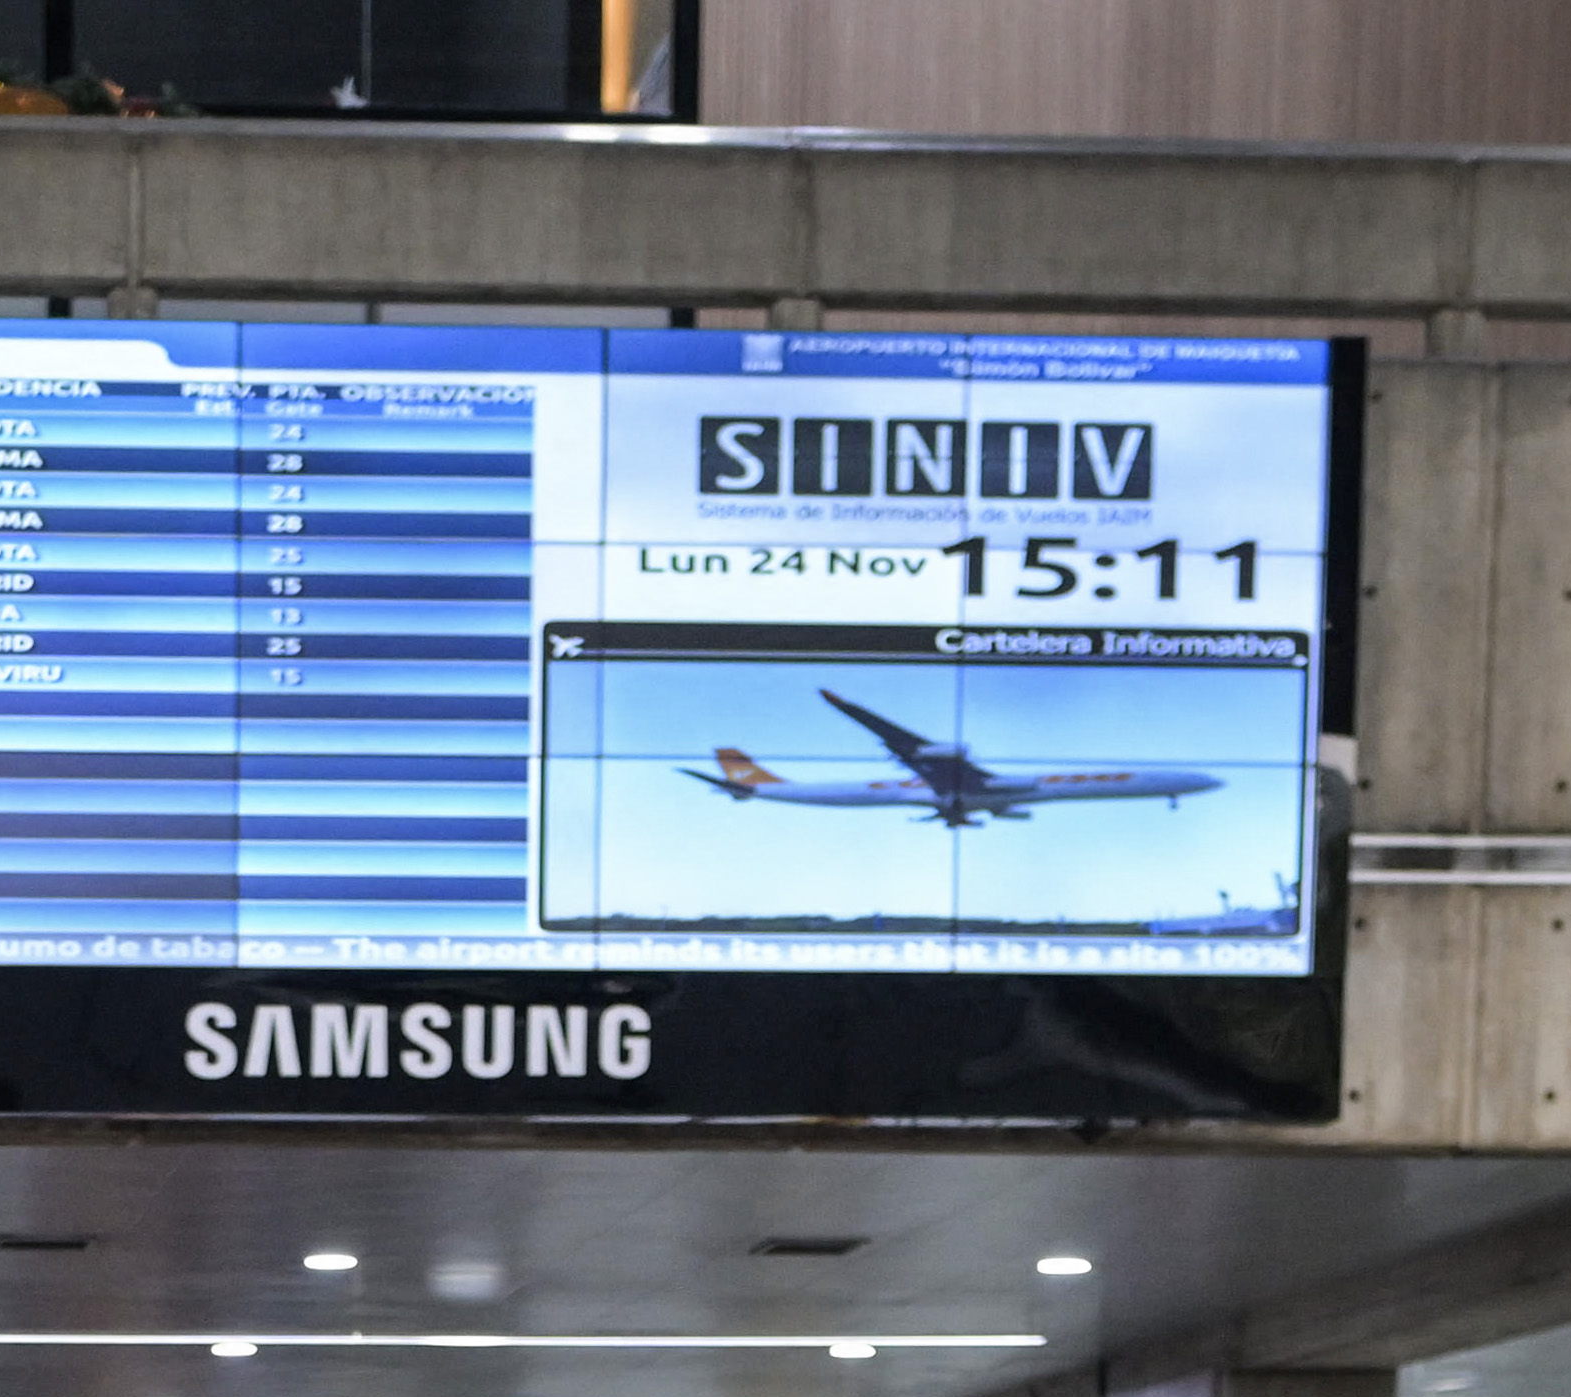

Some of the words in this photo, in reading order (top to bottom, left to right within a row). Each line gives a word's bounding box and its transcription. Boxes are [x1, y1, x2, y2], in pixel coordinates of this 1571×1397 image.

[268, 423, 304, 441] 24
[267, 454, 303, 472] 28
[703, 418, 1151, 499] SINIV
[268, 485, 304, 502] 24
[697, 502, 788, 520] Sistema
[795, 502, 825, 520] de
[979, 505, 1011, 522] de
[1015, 506, 1090, 524] Vuelos
[267, 515, 303, 533] 28
[640, 549, 729, 575] Lun
[750, 549, 806, 575] 24
[829, 548, 927, 577] Nov
[941, 536, 1259, 602] 15:11
[268, 576, 303, 595] 15
[267, 636, 303, 656] 25
[935, 629, 1092, 656] Cartelera
[1103, 632, 1297, 658] Informativa
[92, 935, 141, 959] de
[151, 936, 286, 961] tabaco
[332, 938, 407, 962] The
[414, 937, 555, 968] airport
[562, 938, 722, 963] reminds
[730, 938, 781, 964] its
[789, 944, 896, 965] users
[904, 940, 989, 966] that
[998, 941, 1031, 966] it
[1038, 941, 1071, 967] is
[1108, 942, 1183, 968] site
[1194, 944, 1303, 970] 100%
[184, 1002, 652, 1080] SAMSUNG
